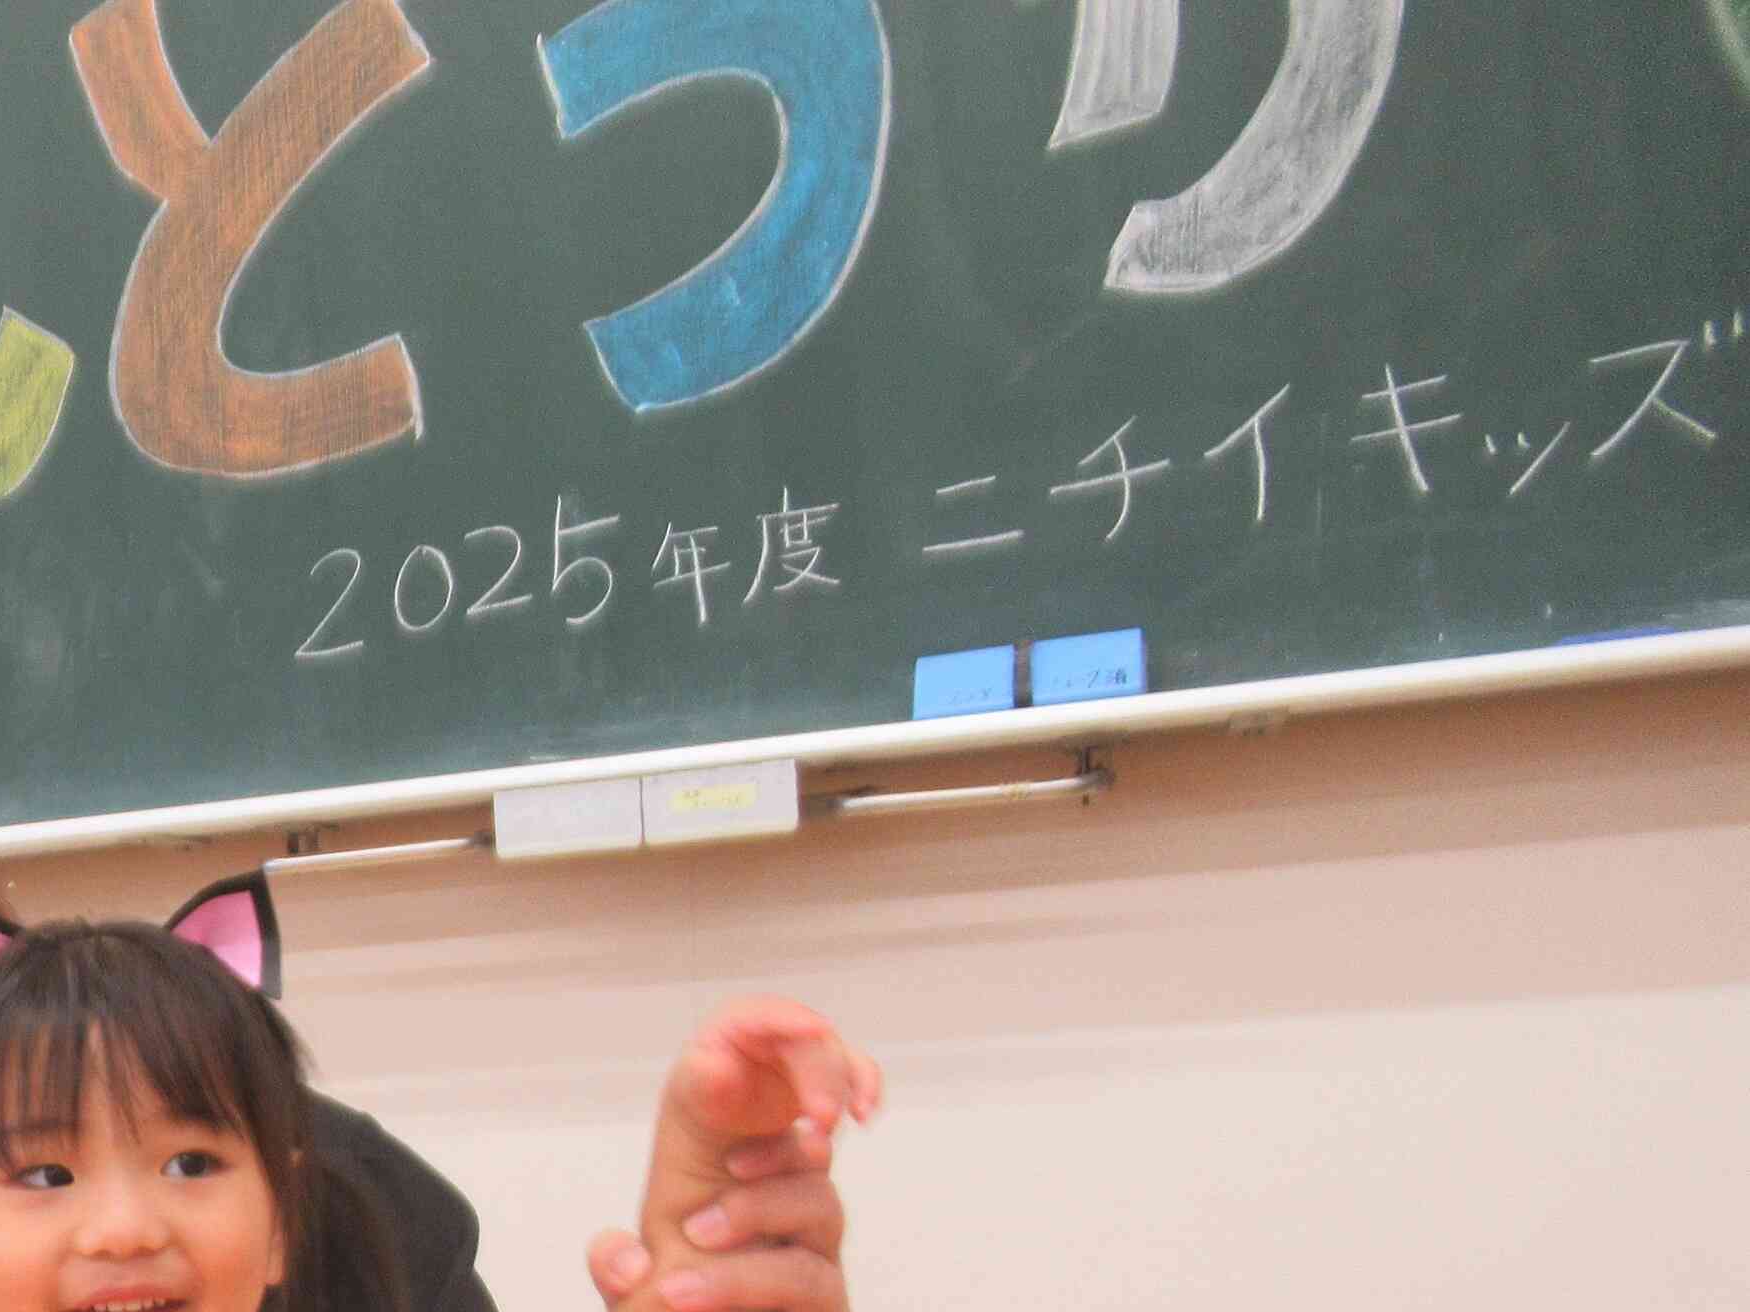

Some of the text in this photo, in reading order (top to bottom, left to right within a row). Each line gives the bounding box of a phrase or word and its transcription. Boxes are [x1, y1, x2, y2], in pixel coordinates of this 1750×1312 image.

[293, 309, 1745, 658] 2025年度 ニチイキッズ
